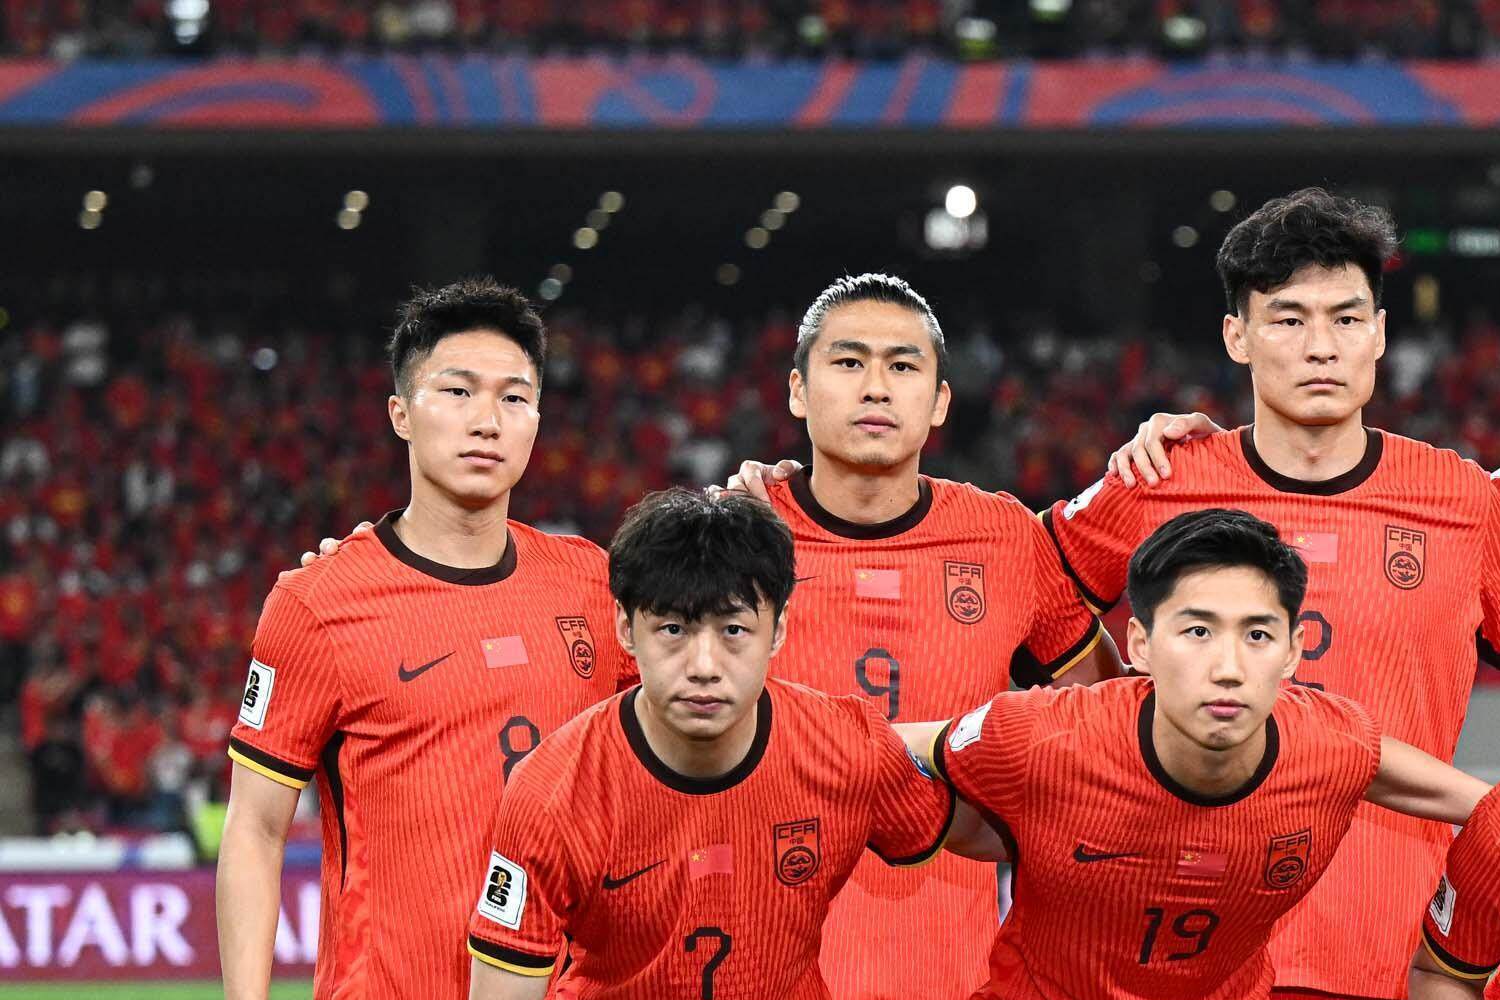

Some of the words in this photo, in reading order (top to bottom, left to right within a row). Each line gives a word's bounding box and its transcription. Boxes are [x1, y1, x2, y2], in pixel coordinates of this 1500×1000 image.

[1389, 529, 1422, 546] CFA
[949, 564, 981, 580] CFA
[559, 620, 588, 631] CFA
[855, 647, 900, 722] 9
[778, 824, 817, 840] CFA
[1274, 836, 1308, 850] CFA
[0, 883, 196, 968] TAR
[1138, 907, 1220, 966] 19
[684, 926, 732, 1000] 7
